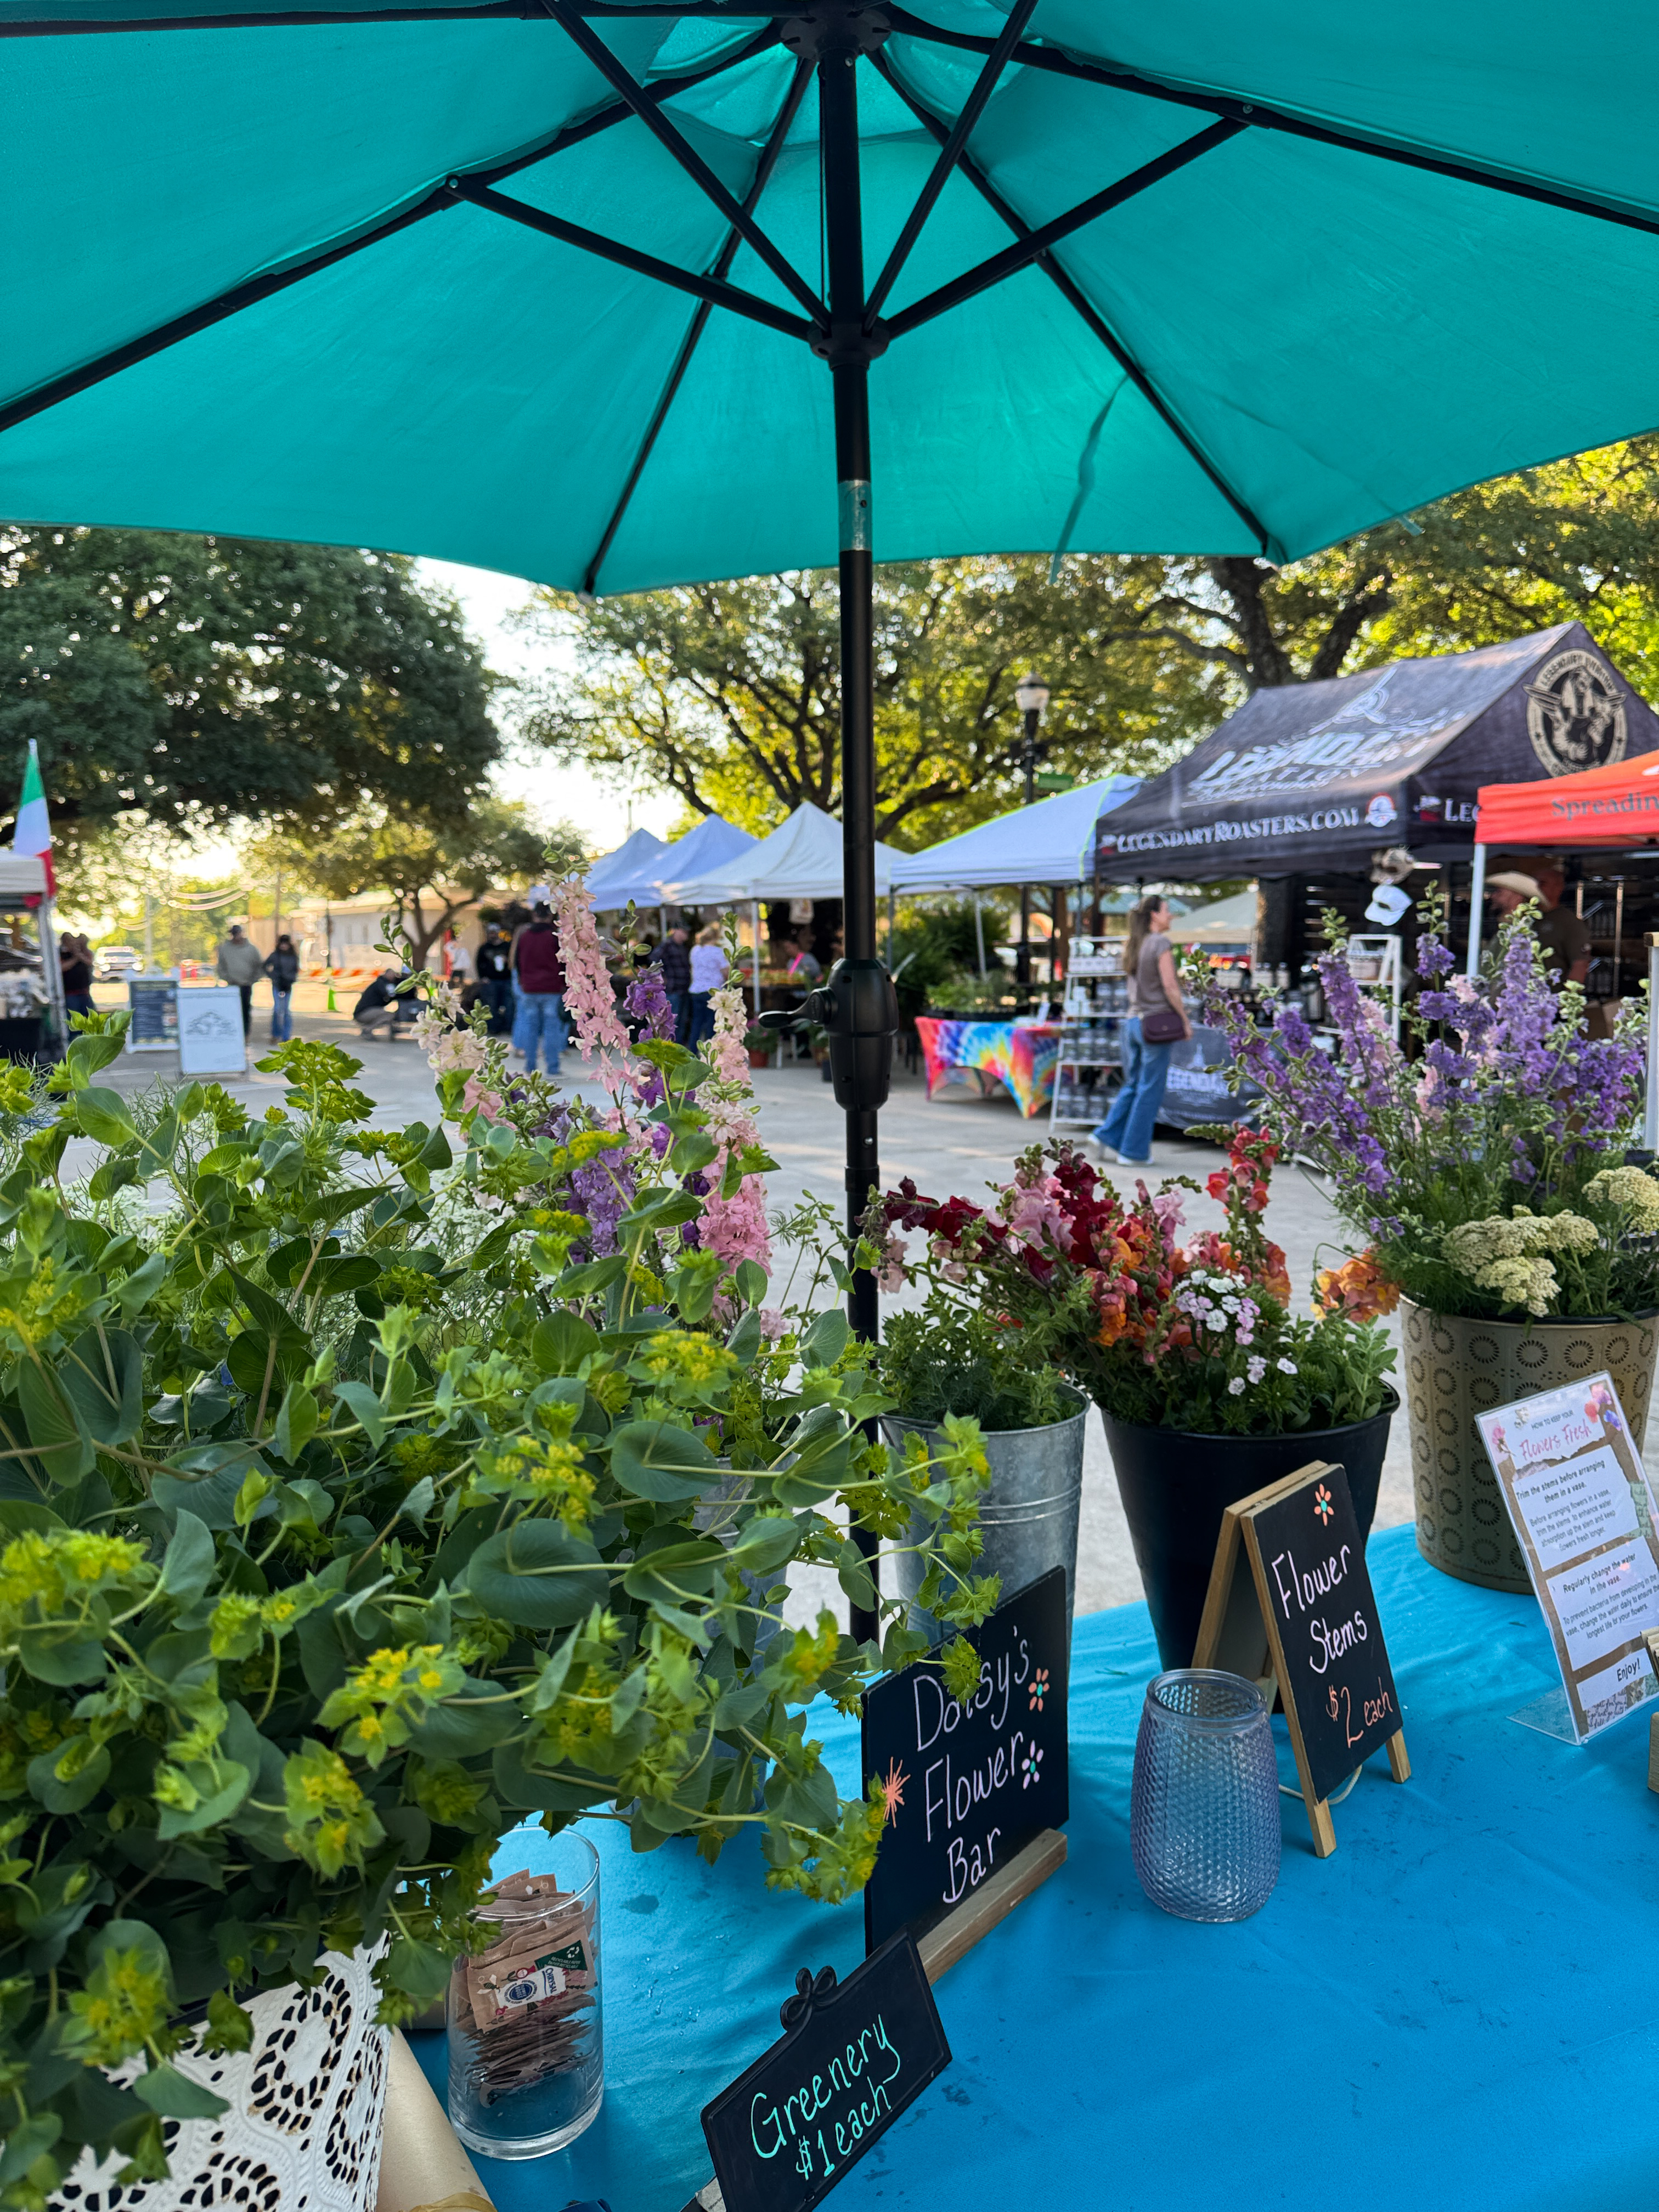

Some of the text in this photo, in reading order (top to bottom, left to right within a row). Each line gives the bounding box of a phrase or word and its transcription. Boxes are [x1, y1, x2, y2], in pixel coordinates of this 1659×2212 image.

[1519, 1418, 1592, 1460] Flowers Fresh
[1531, 1421, 1544, 1430] HOW
[1550, 1414, 1561, 1423] KEEP
[1516, 1460, 1605, 1500] Trim the stems before arranging
[1544, 1492, 1559, 1503] them
[1572, 1482, 1587, 1491] vase.
[1530, 1515, 1547, 1527] Before
[1548, 1505, 1571, 1519] arranging
[1570, 1498, 1588, 1509] flowers
[1536, 1528, 1547, 1537] trim
[1556, 1517, 1571, 1528] stems
[1595, 1514, 1604, 1523] and
[1271, 1544, 1351, 1619] Flower
[1563, 1553, 1635, 1593] Regularly change the water
[1596, 1582, 1606, 1591] the
[1607, 1575, 1622, 1586] vase.
[1563, 1617, 1570, 1625] To
[1570, 1607, 1589, 1624] prevent
[1589, 1598, 1609, 1613] bacteria
[1609, 1593, 1620, 1602] from
[1621, 1581, 1645, 1597] developing
[1580, 1616, 1598, 1630] change
[1599, 1612, 1607, 1621] the
[1607, 1605, 1619, 1616] water
[1620, 1598, 1632, 1609] daily
[1638, 1588, 1652, 1601] ensure
[1310, 1610, 1368, 1674] Stems
[1587, 1624, 1605, 1639] longest
[1618, 1611, 1630, 1624] your
[913, 1624, 1029, 1752] Daisy's
[1617, 1657, 1640, 1682] Enjoy!
[1326, 1676, 1393, 1748] $2 each
[924, 1730, 1024, 1843] Flower
[941, 1826, 1001, 1904] Bar
[545, 1967, 557, 1994] CHRYSAL
[751, 2013, 901, 2159] Greenery
[795, 2076, 892, 2181] $1 each
